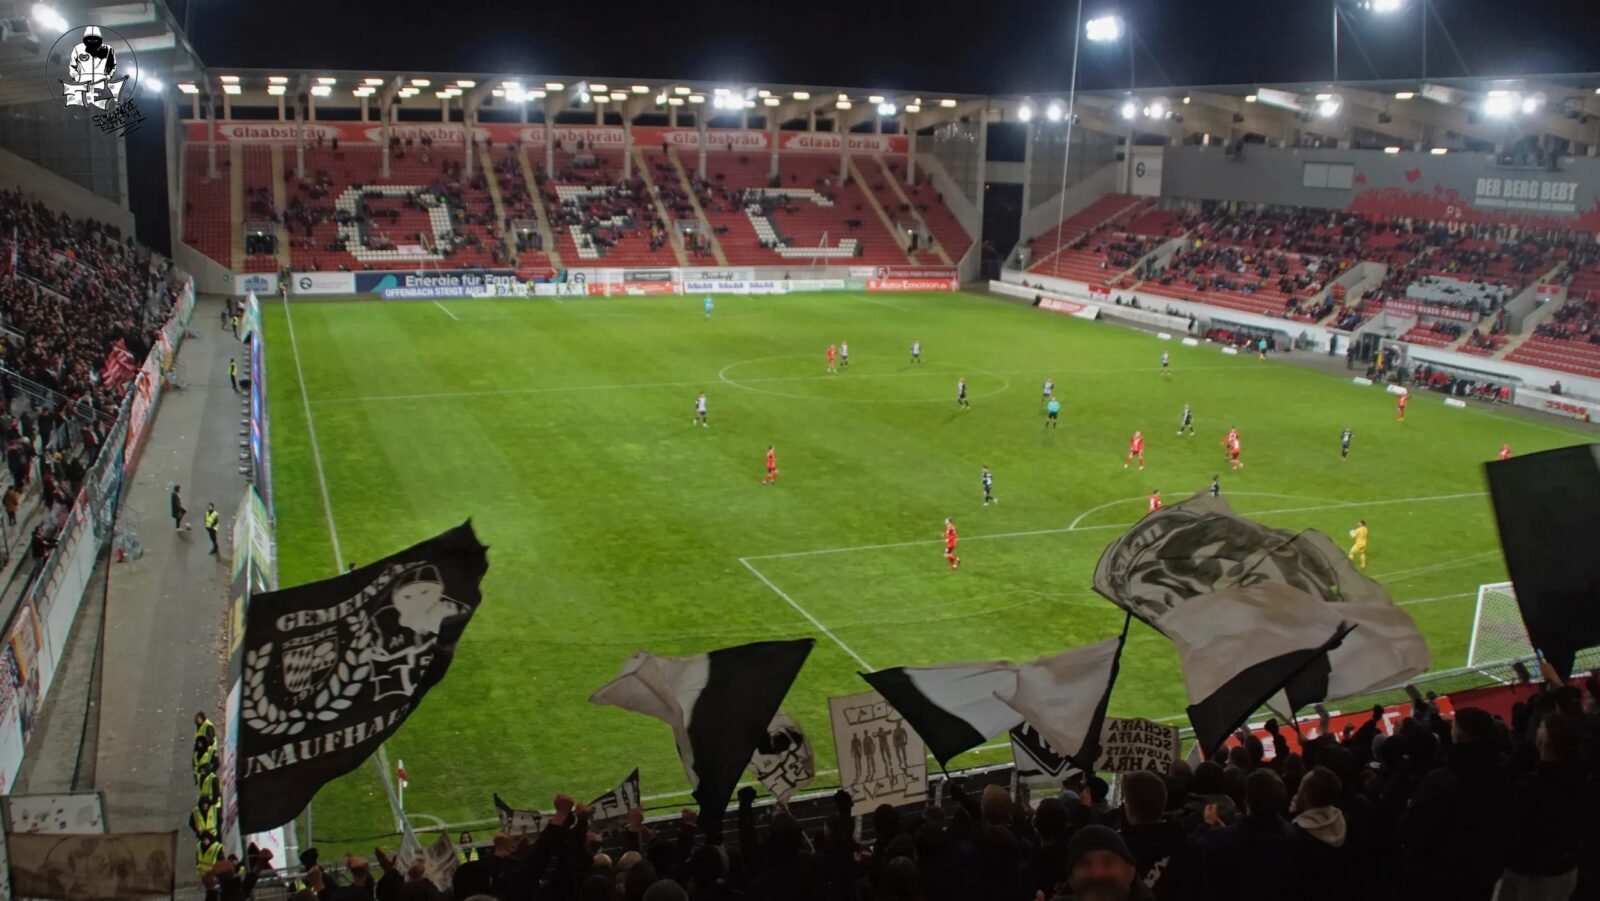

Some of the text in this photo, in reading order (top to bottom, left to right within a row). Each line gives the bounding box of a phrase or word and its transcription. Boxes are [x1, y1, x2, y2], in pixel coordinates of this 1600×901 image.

[673, 133, 760, 145] Glabsbräu
[799, 136, 880, 149] Glaabbräu
[1476, 179, 1578, 201] DER BERG BEBT
[462, 274, 481, 286] für
[385, 287, 434, 297] OFFENBACH
